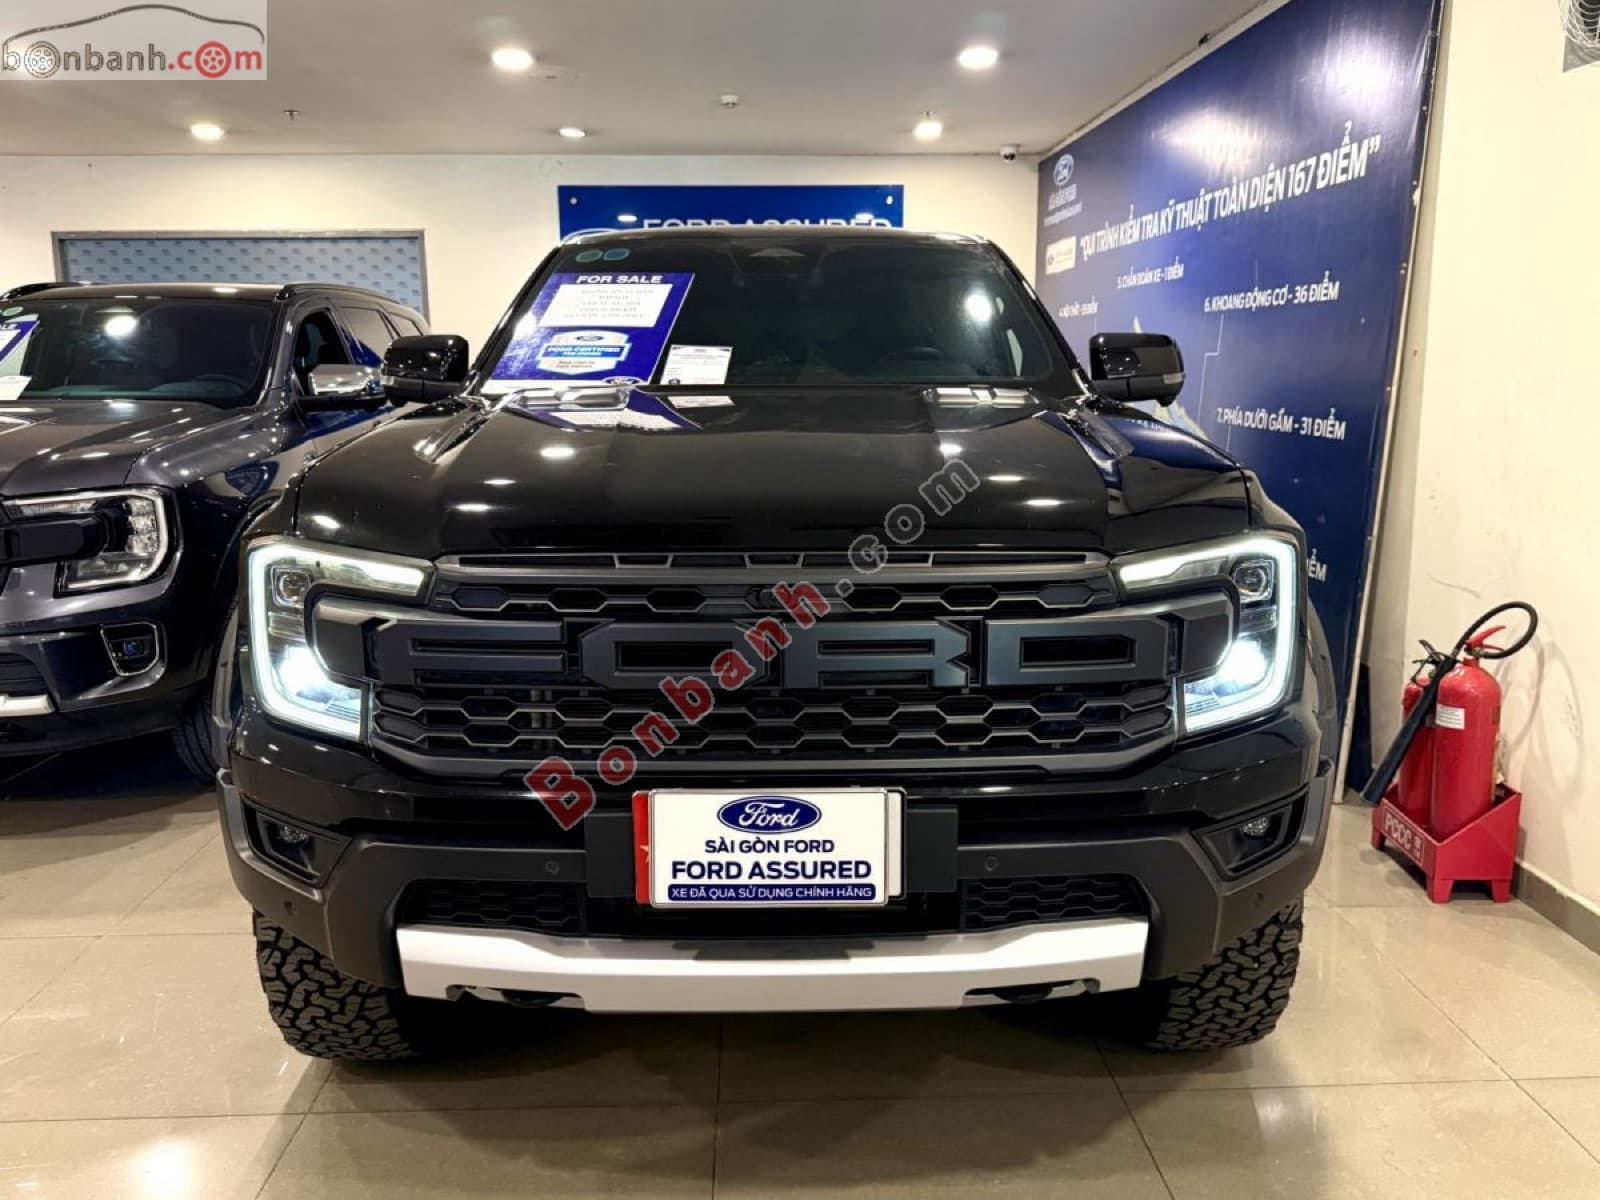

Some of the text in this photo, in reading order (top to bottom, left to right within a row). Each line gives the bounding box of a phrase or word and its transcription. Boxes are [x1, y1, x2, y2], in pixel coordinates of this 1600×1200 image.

[1141, 213, 1160, 240] TRA
[1175, 188, 1213, 232] THUẬT
[1213, 175, 1249, 220] TOÀN
[1250, 162, 1287, 213] DIỆN
[1287, 155, 1318, 198] 167
[576, 275, 664, 284] FOR SALE
[1245, 286, 1272, 312] ĐỘNG
[1272, 284, 1289, 306] CƠ
[1293, 284, 1309, 304] 36
[1308, 270, 1340, 303] ĐIỂM
[1299, 416, 1312, 436] 31
[1312, 407, 1346, 440] ĐIỂM
[377, 619, 1168, 689] FORD
[738, 802, 800, 828] Ford
[704, 836, 835, 854] SÀI GÒN FORD
[672, 860, 872, 880] FORD ASSURED
[671, 885, 872, 900] XE ĐÃ QUA SỬ DỤNG CHÍNH HÃNG
